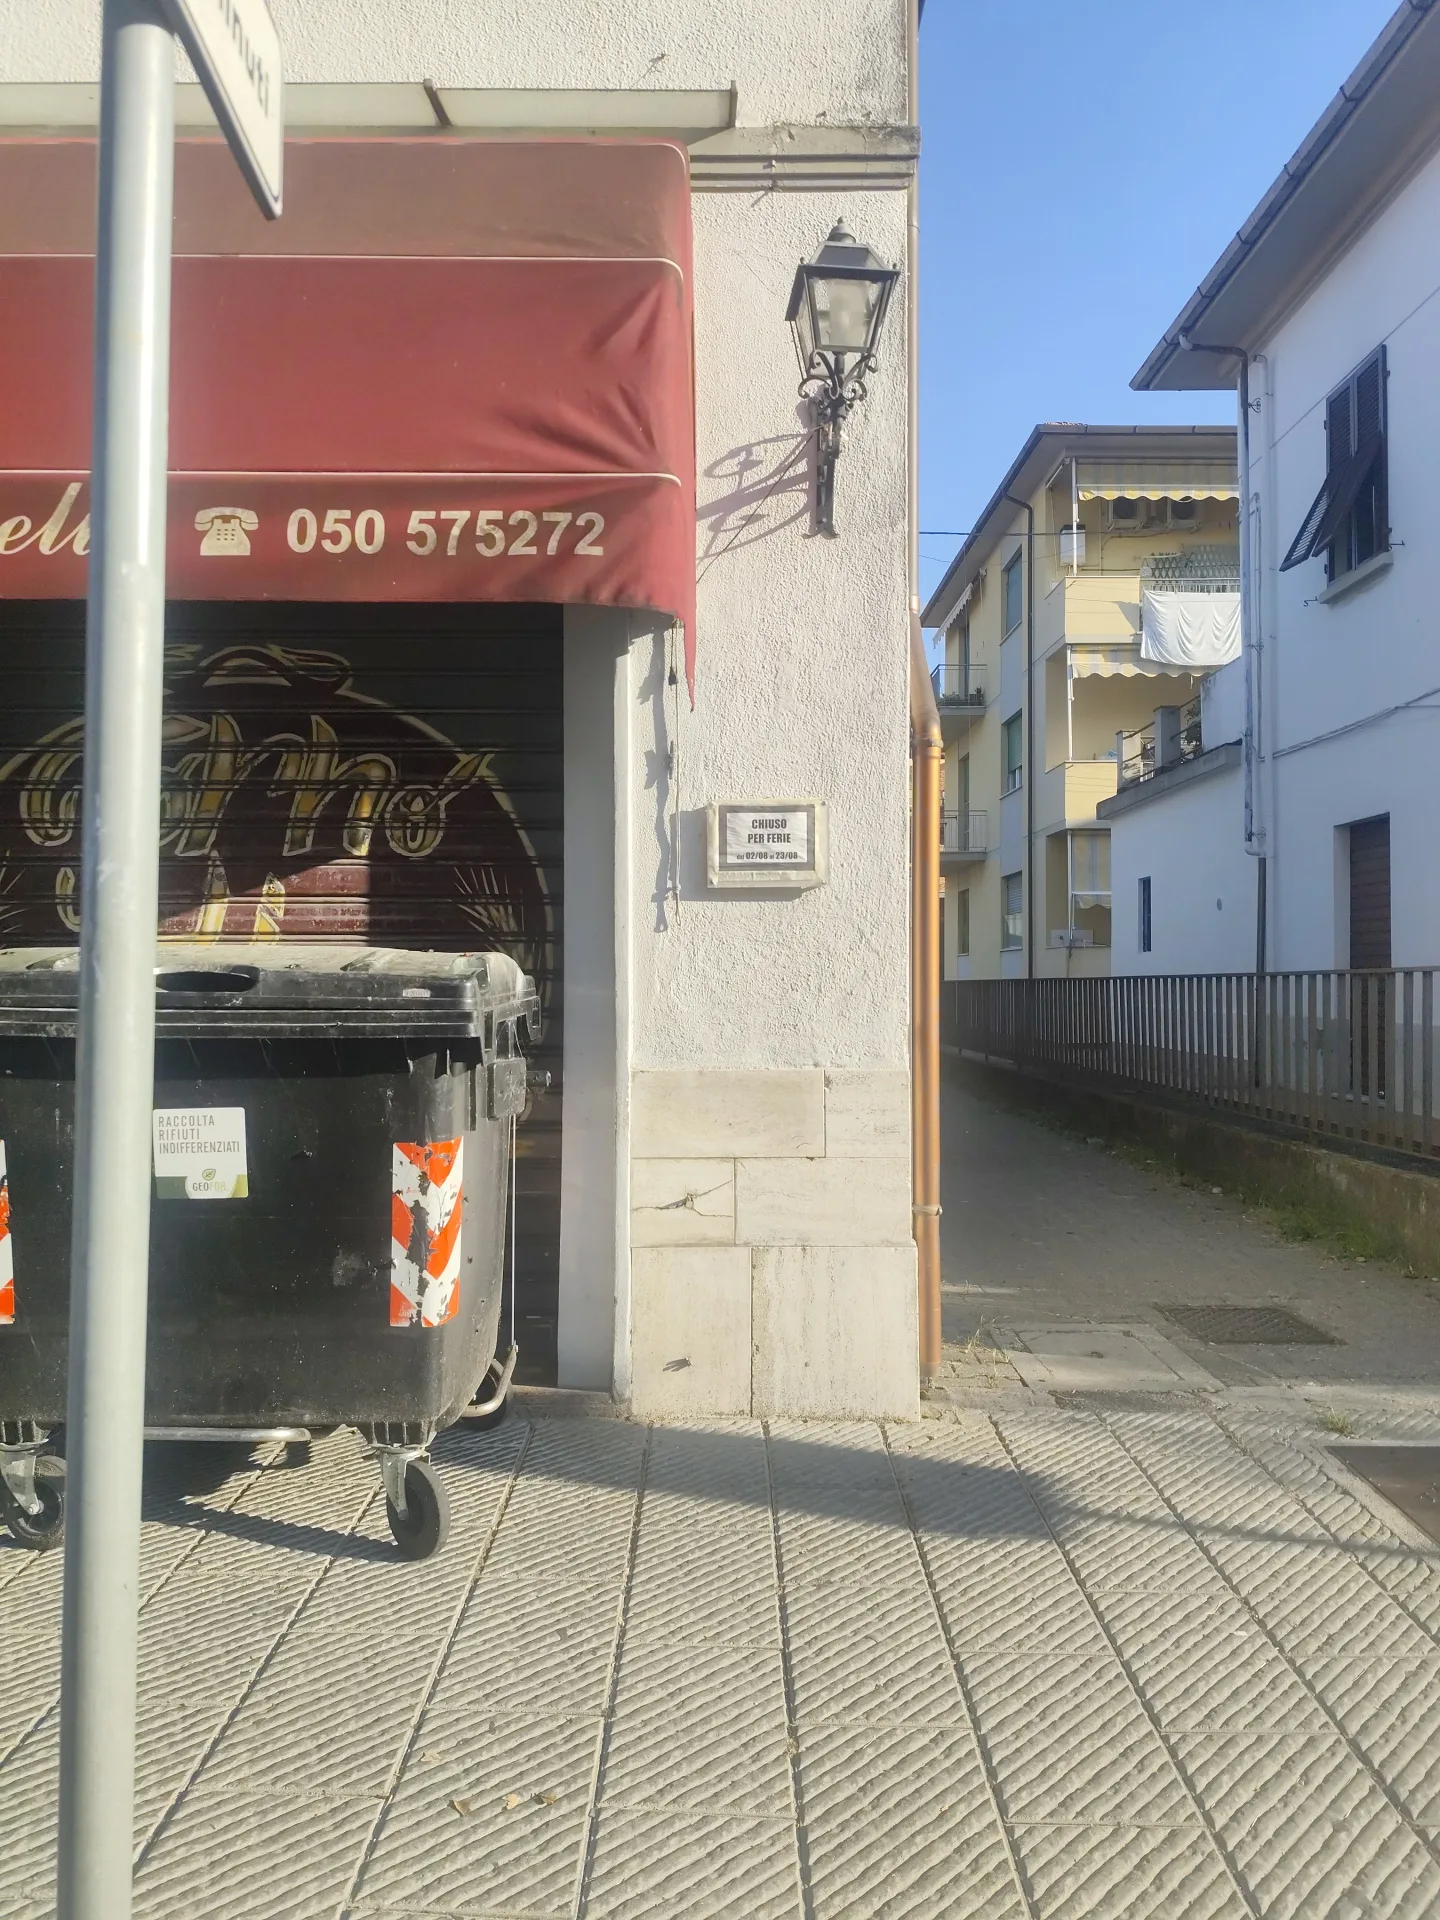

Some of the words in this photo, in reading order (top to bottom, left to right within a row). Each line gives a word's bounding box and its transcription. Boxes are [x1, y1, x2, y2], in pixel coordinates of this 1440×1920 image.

[287, 508, 385, 554] 050
[406, 510, 605, 557] 575272
[751, 819, 787, 829] CHIUSO
[748, 833, 764, 843] PER
[767, 833, 791, 843] FERIE
[745, 851, 768, 860] 02/08
[775, 851, 798, 860] 23/08
[158, 1115, 215, 1127] RACCOLTA
[159, 1128, 200, 1141] RIFIUTI
[159, 1141, 240, 1154] INDIFFERENZIATI
